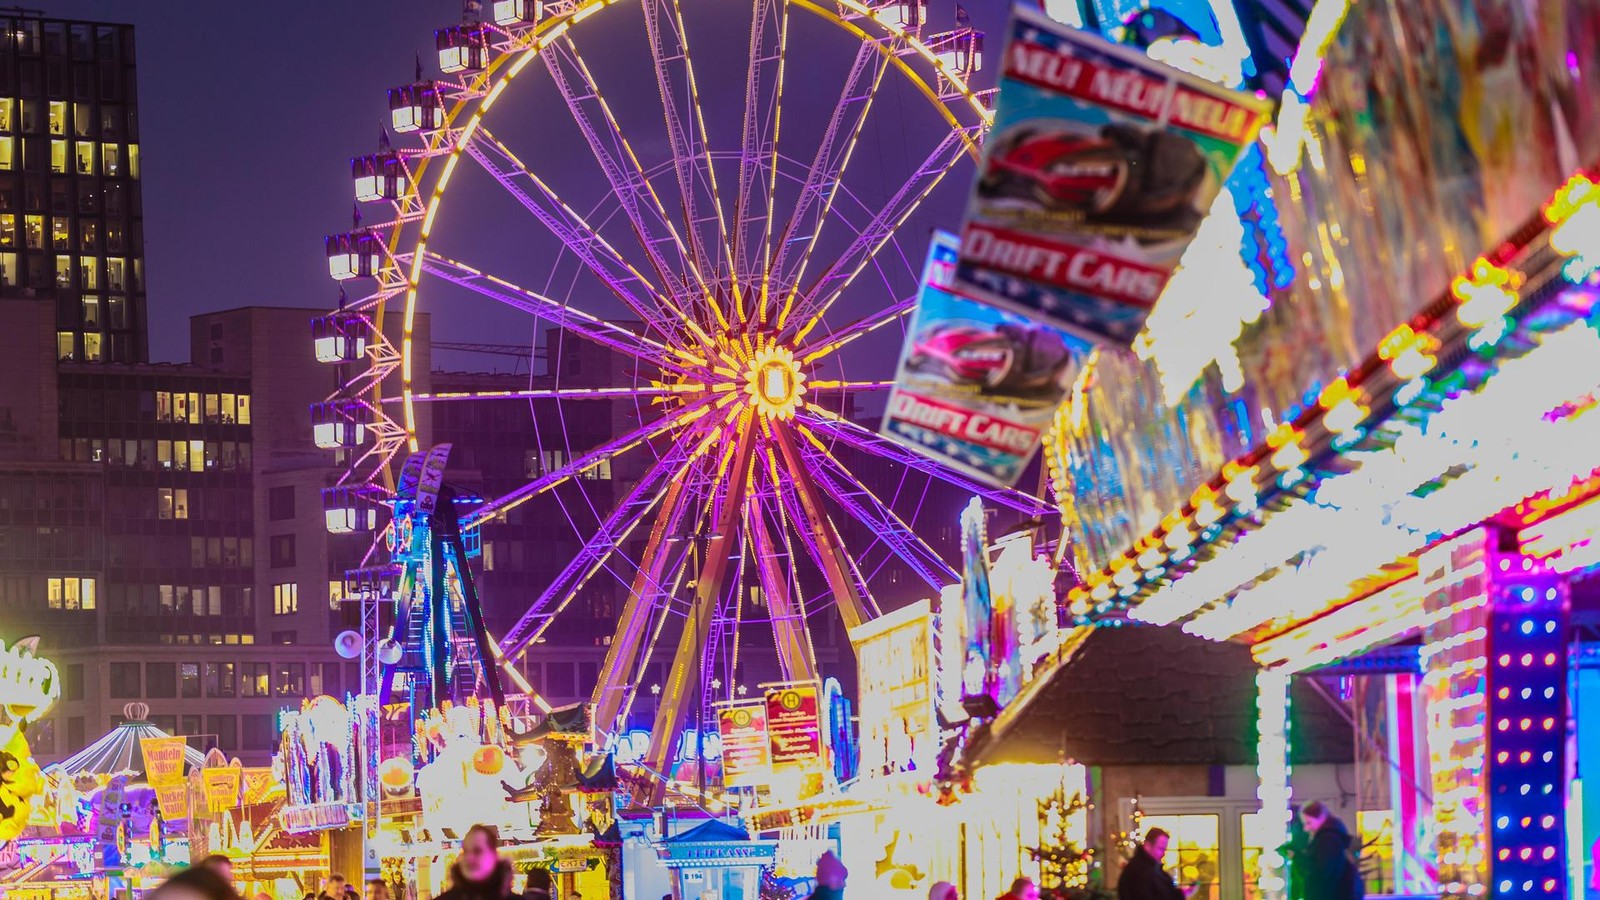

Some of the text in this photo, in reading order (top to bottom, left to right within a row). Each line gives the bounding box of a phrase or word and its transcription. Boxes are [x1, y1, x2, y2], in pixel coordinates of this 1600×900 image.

[965, 228, 1068, 280] DRIFT
[1064, 251, 1165, 299] CARS
[892, 393, 1036, 451] DRIFT CARS
[146, 748, 181, 761] Mandeln
[369, 849, 376, 860] 3
